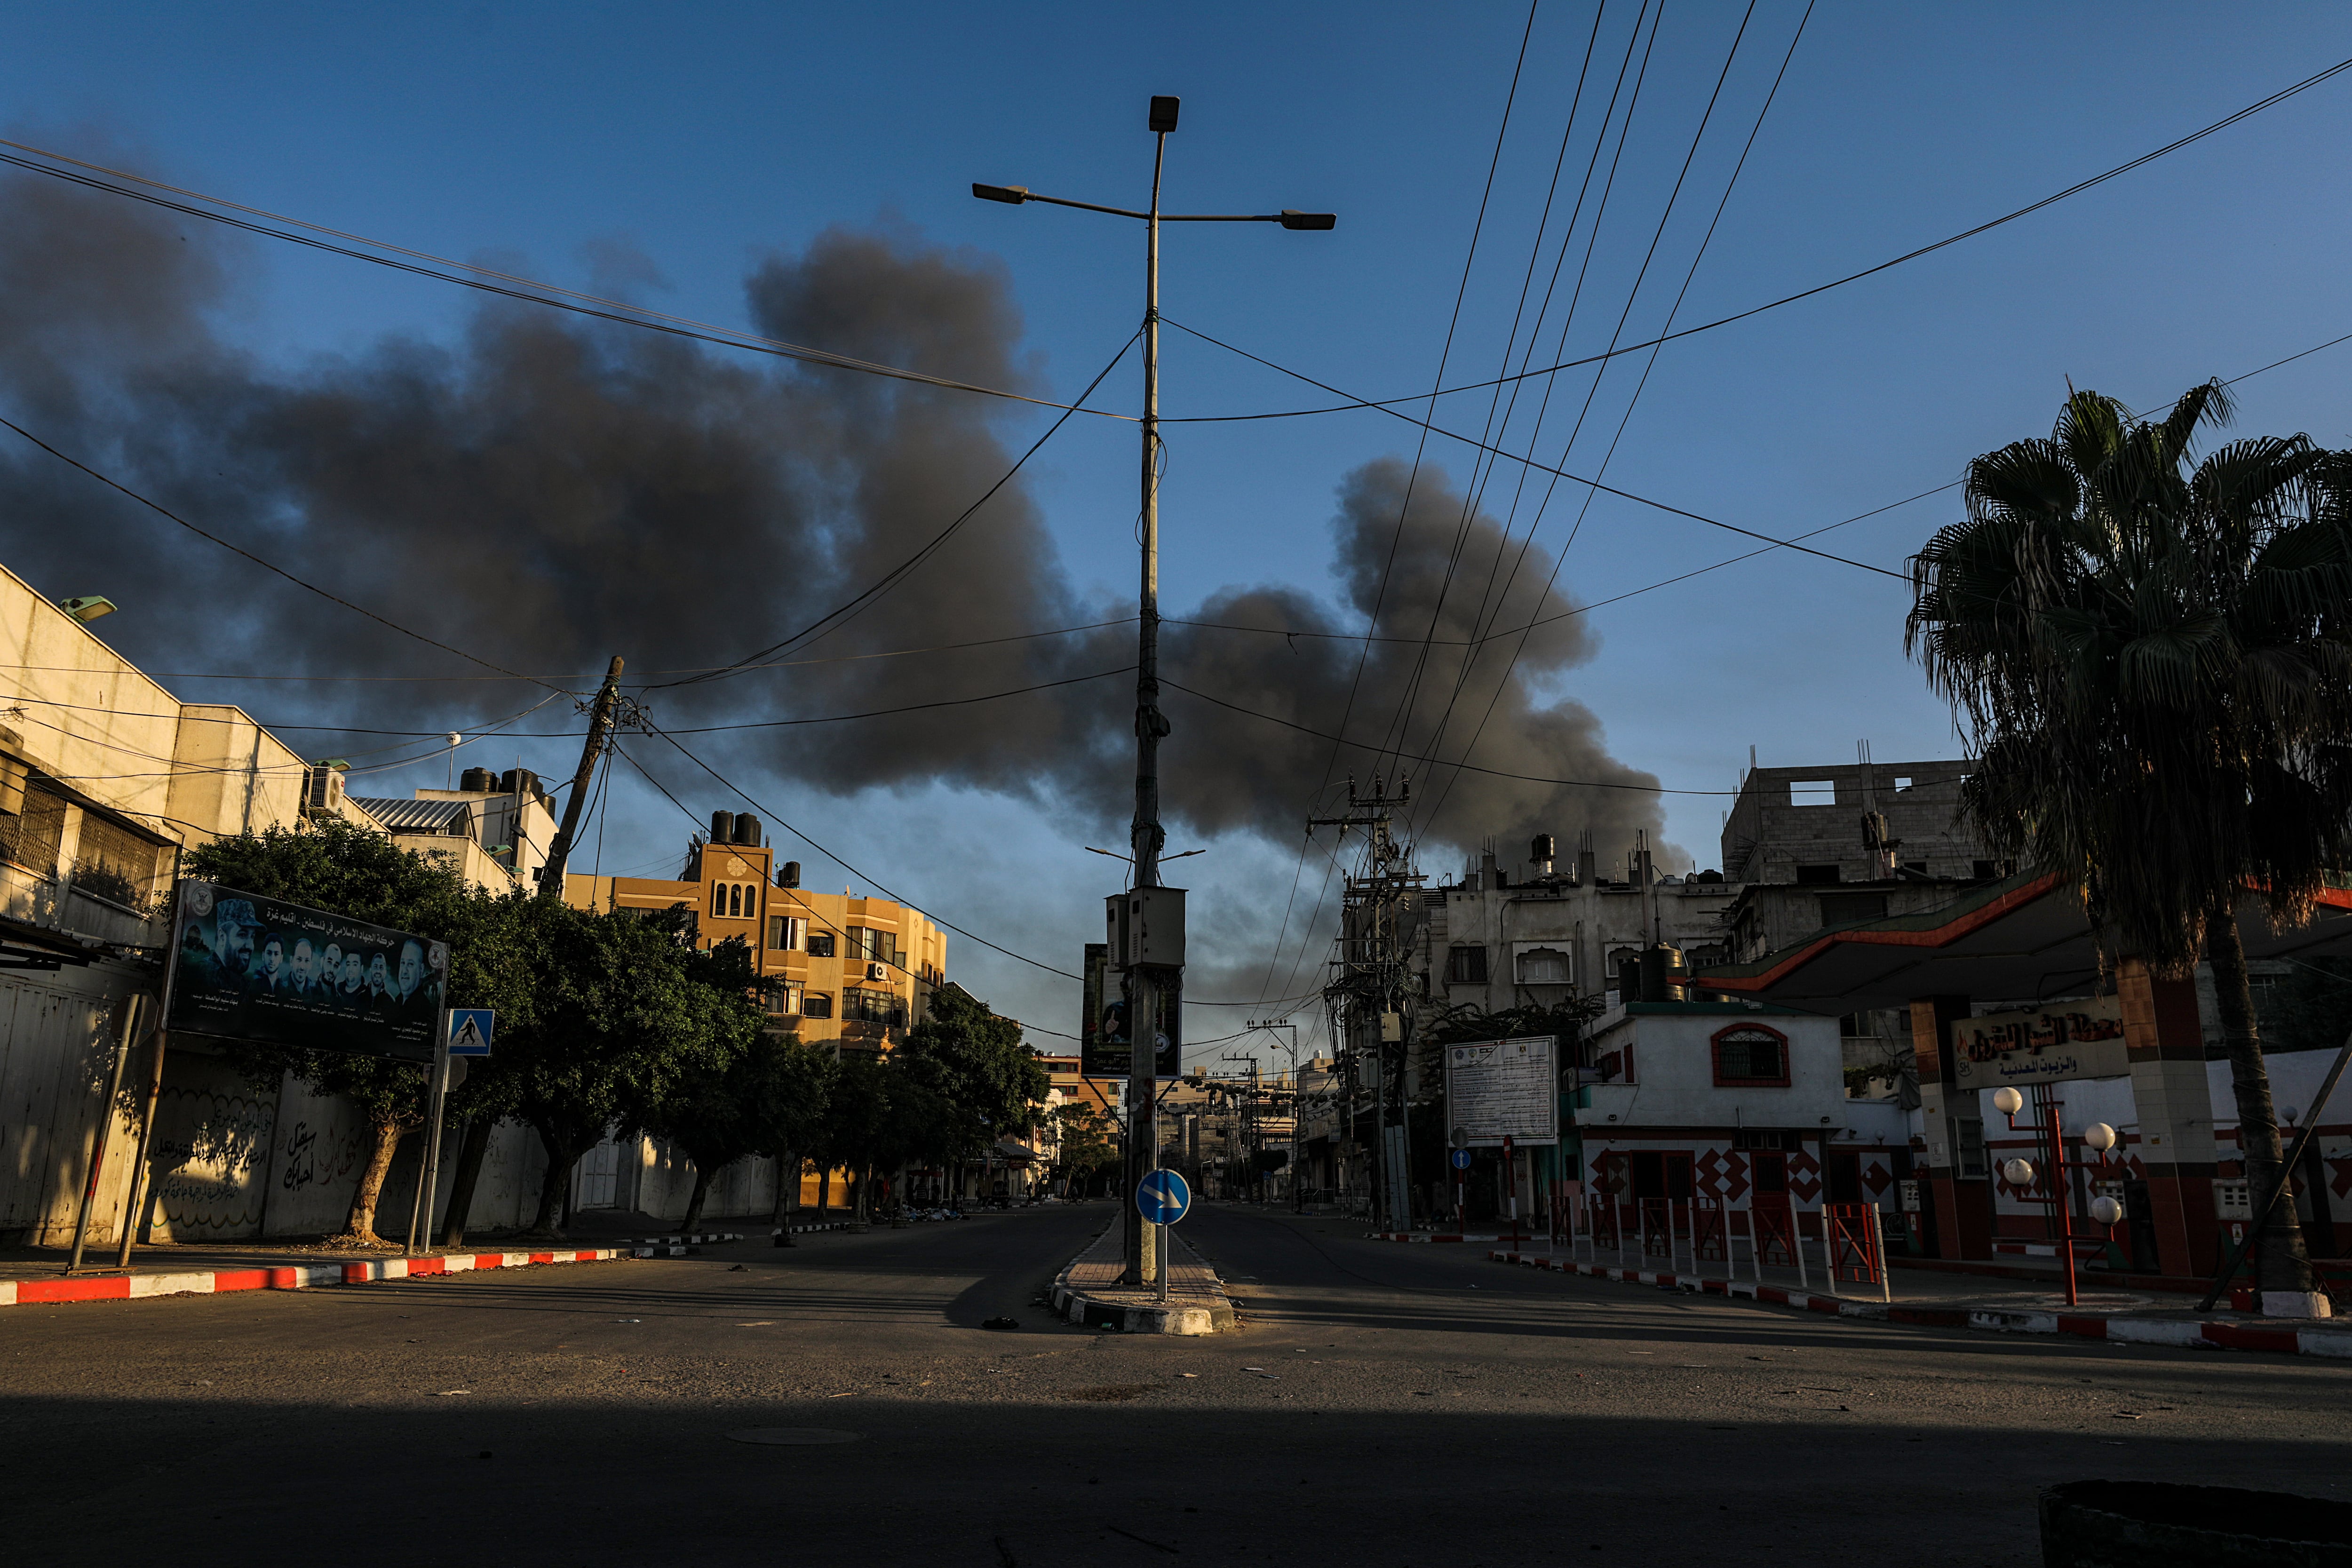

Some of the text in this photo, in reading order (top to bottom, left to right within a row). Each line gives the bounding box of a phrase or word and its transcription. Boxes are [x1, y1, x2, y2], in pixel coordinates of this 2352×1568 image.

[266, 907, 279, 921] غزة
[302, 916, 326, 931] فلسطين
[326, 922, 334, 936] في
[359, 930, 376, 943] الجهاد
[377, 934, 395, 947] حركة
[2023, 1014, 2066, 1055] الشوا
[2066, 1013, 2124, 1042] محطة
[1959, 1061, 1970, 1073] SH
[2000, 1056, 2077, 1078] والزيوت المعدنية
[192, 1105, 222, 1131] على
[288, 1121, 317, 1156] سيقتل
[284, 1152, 314, 1191] أحبابك
